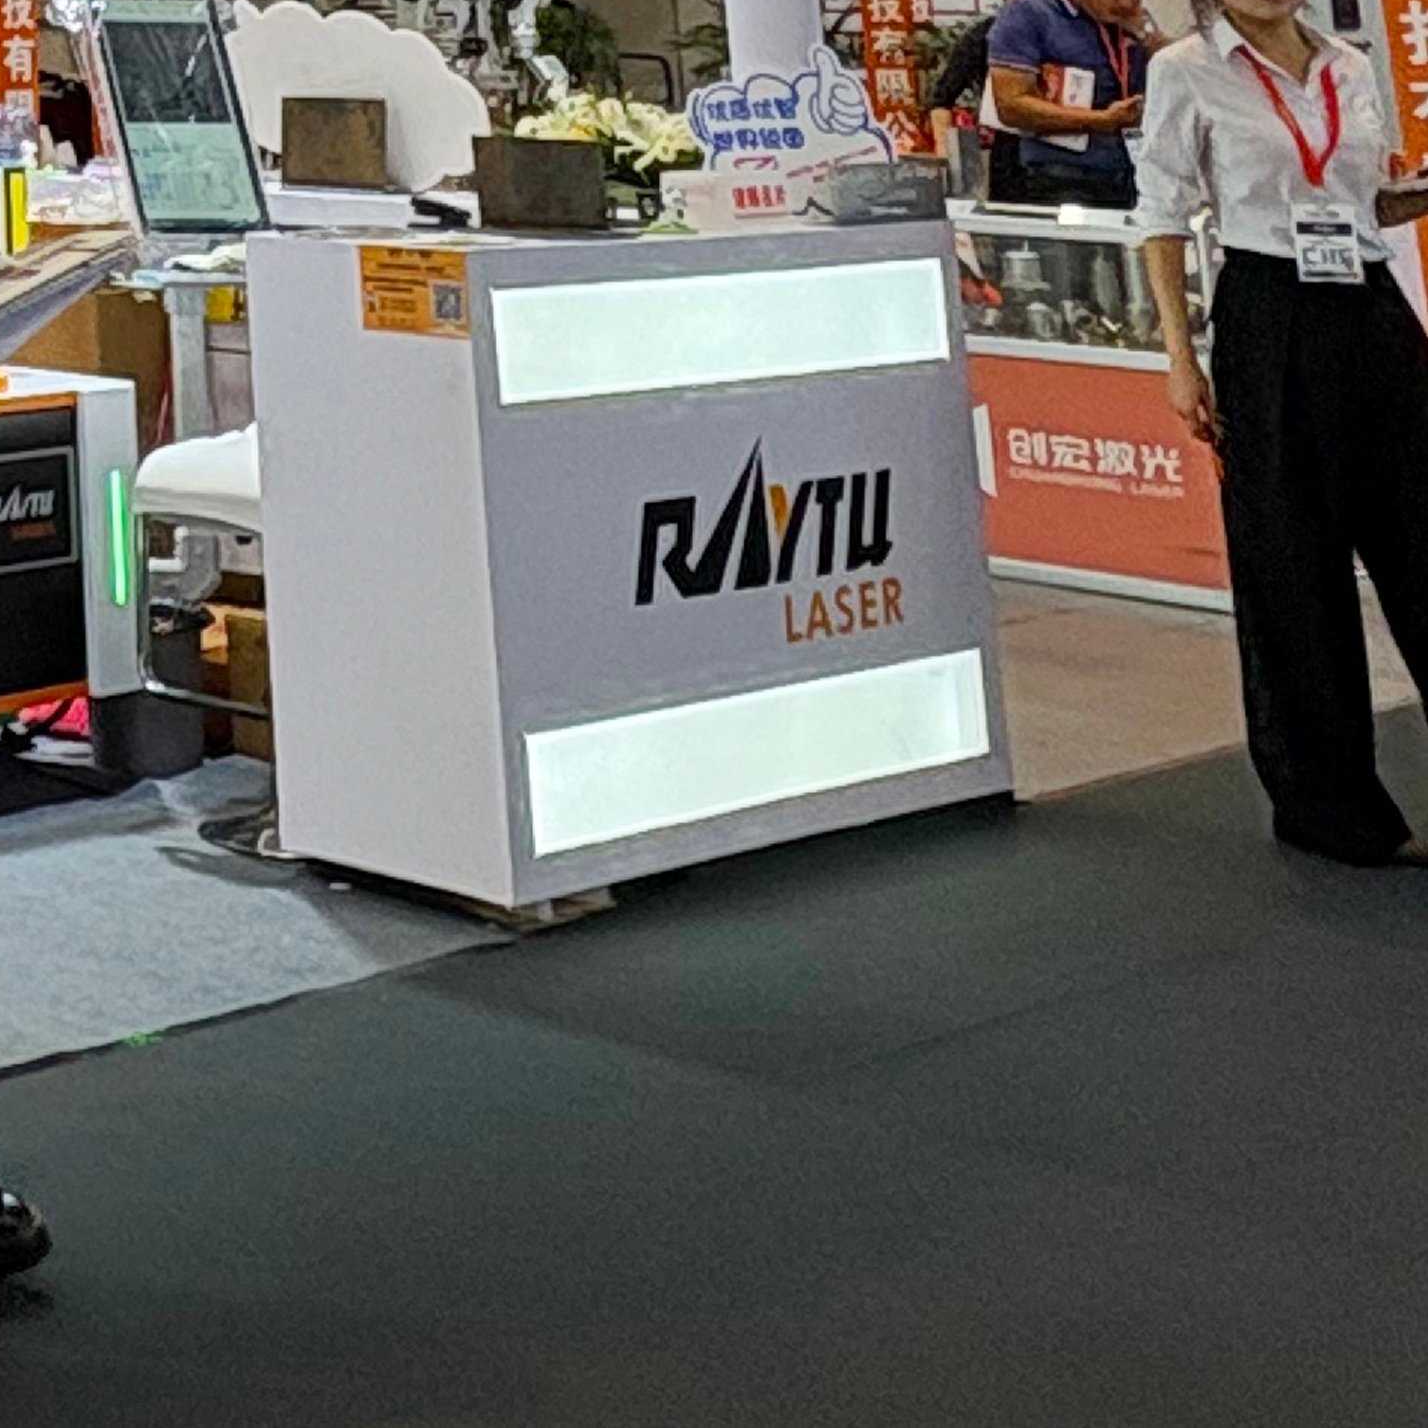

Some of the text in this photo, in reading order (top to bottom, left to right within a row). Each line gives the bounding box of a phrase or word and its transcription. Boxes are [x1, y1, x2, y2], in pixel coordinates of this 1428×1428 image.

[1007, 428, 1184, 483] 创宏激光
[634, 435, 893, 606] RAYTU
[784, 577, 904, 644] LASER
